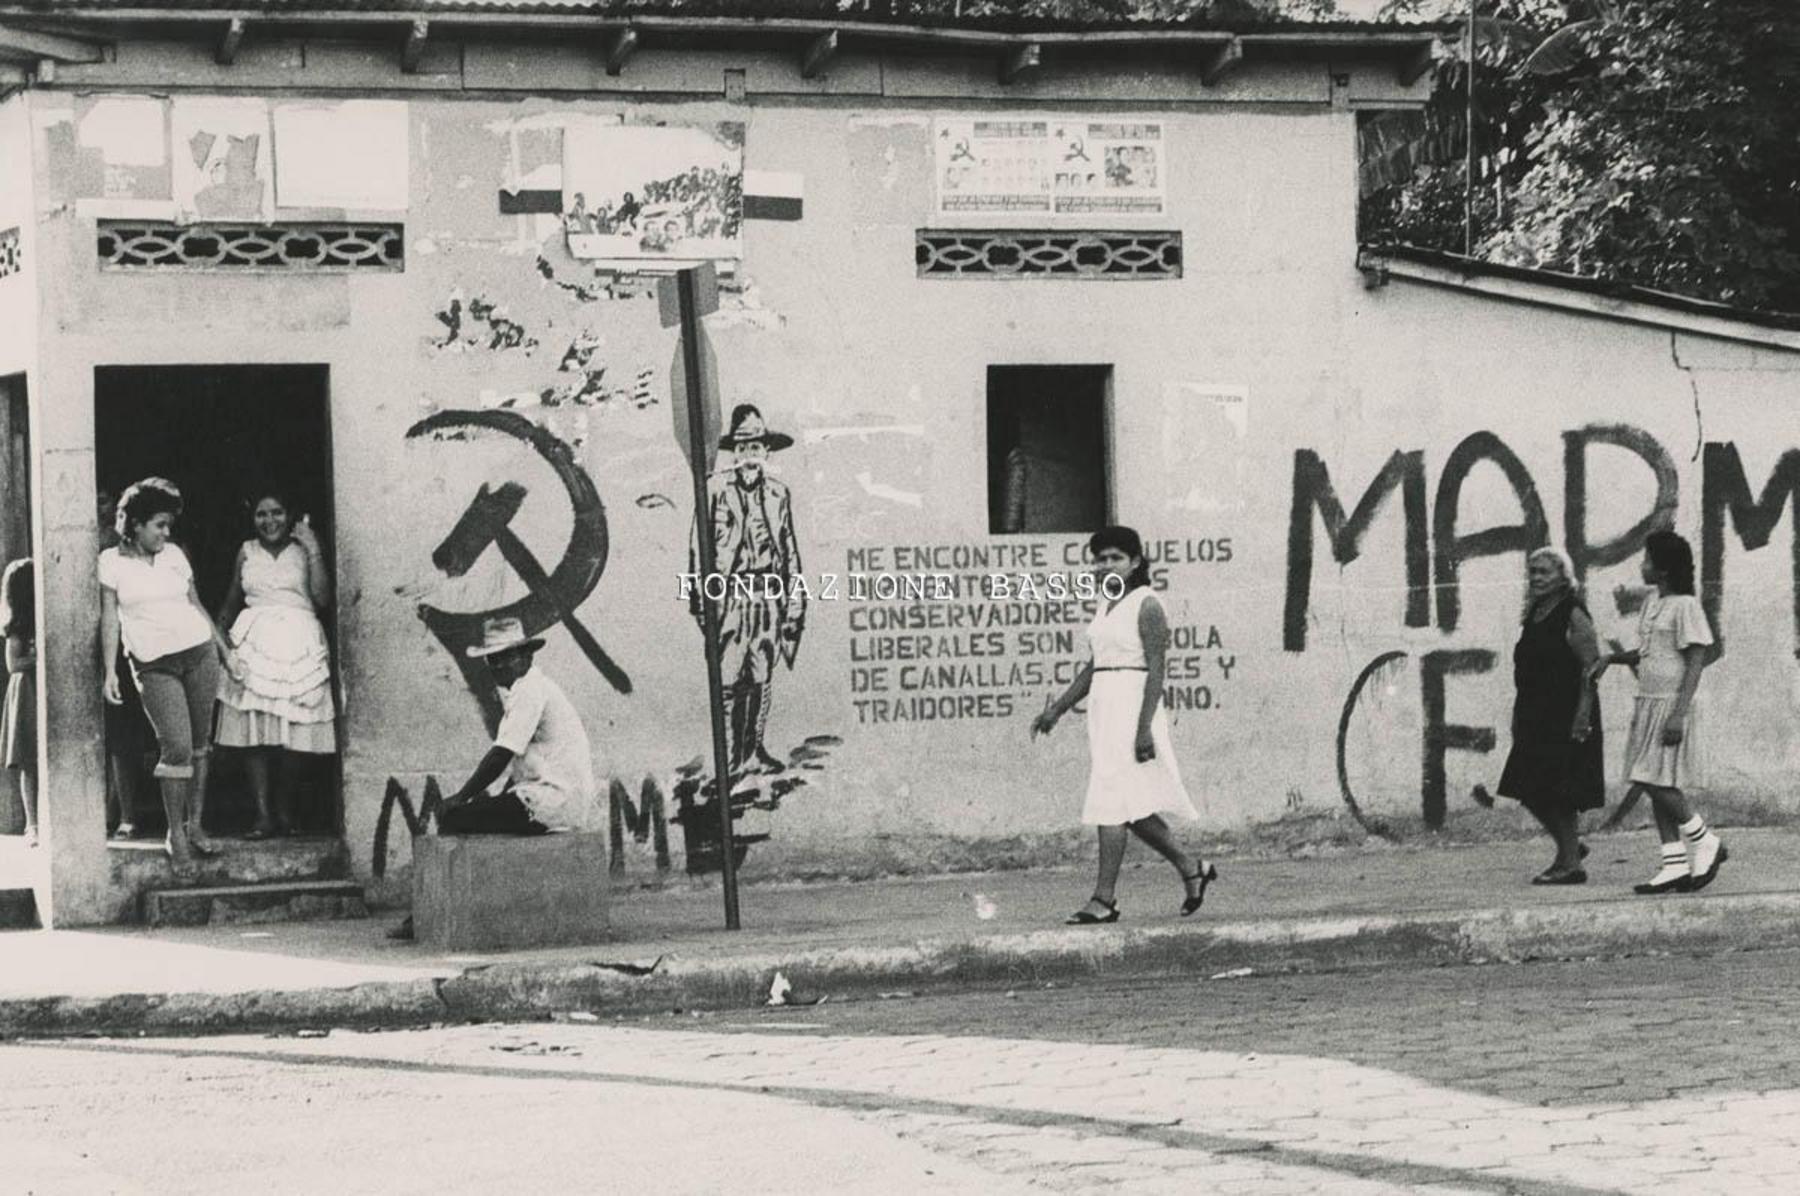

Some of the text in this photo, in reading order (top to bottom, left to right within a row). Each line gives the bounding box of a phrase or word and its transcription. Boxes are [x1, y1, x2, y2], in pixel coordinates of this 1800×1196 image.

[847, 547, 885, 571] ME
[894, 544, 1048, 570] ENCONTRE
[1186, 538, 1233, 563] LOS
[849, 600, 1098, 632] CONSERVADORES
[850, 632, 1005, 662] LIBERALES
[1018, 629, 1074, 656] SON
[851, 667, 889, 693] DE
[1218, 655, 1236, 681] Y
